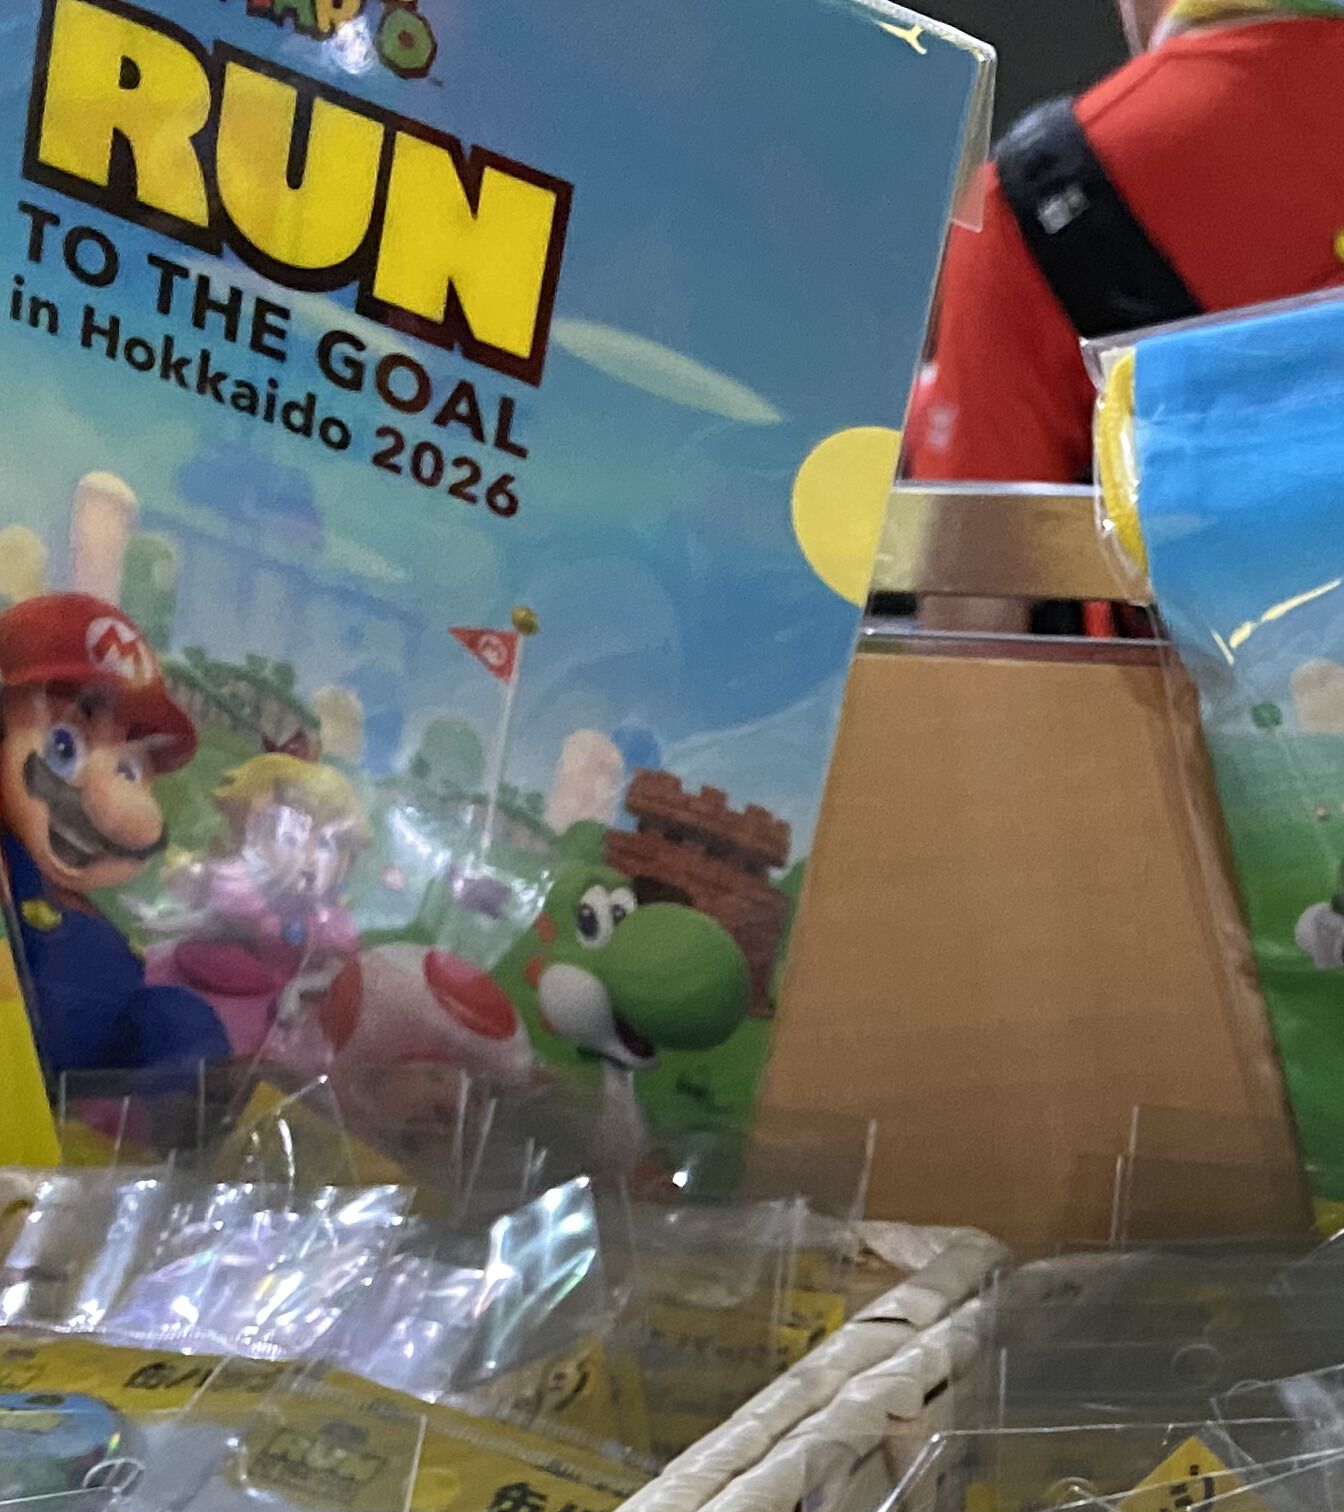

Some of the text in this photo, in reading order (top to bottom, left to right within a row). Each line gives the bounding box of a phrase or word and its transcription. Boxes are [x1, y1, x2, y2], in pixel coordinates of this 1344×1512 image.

[22, 0, 573, 388] RUN
[9, 277, 520, 518] in Hokkaido 2026
[18, 201, 528, 458] TO THE GOAL
